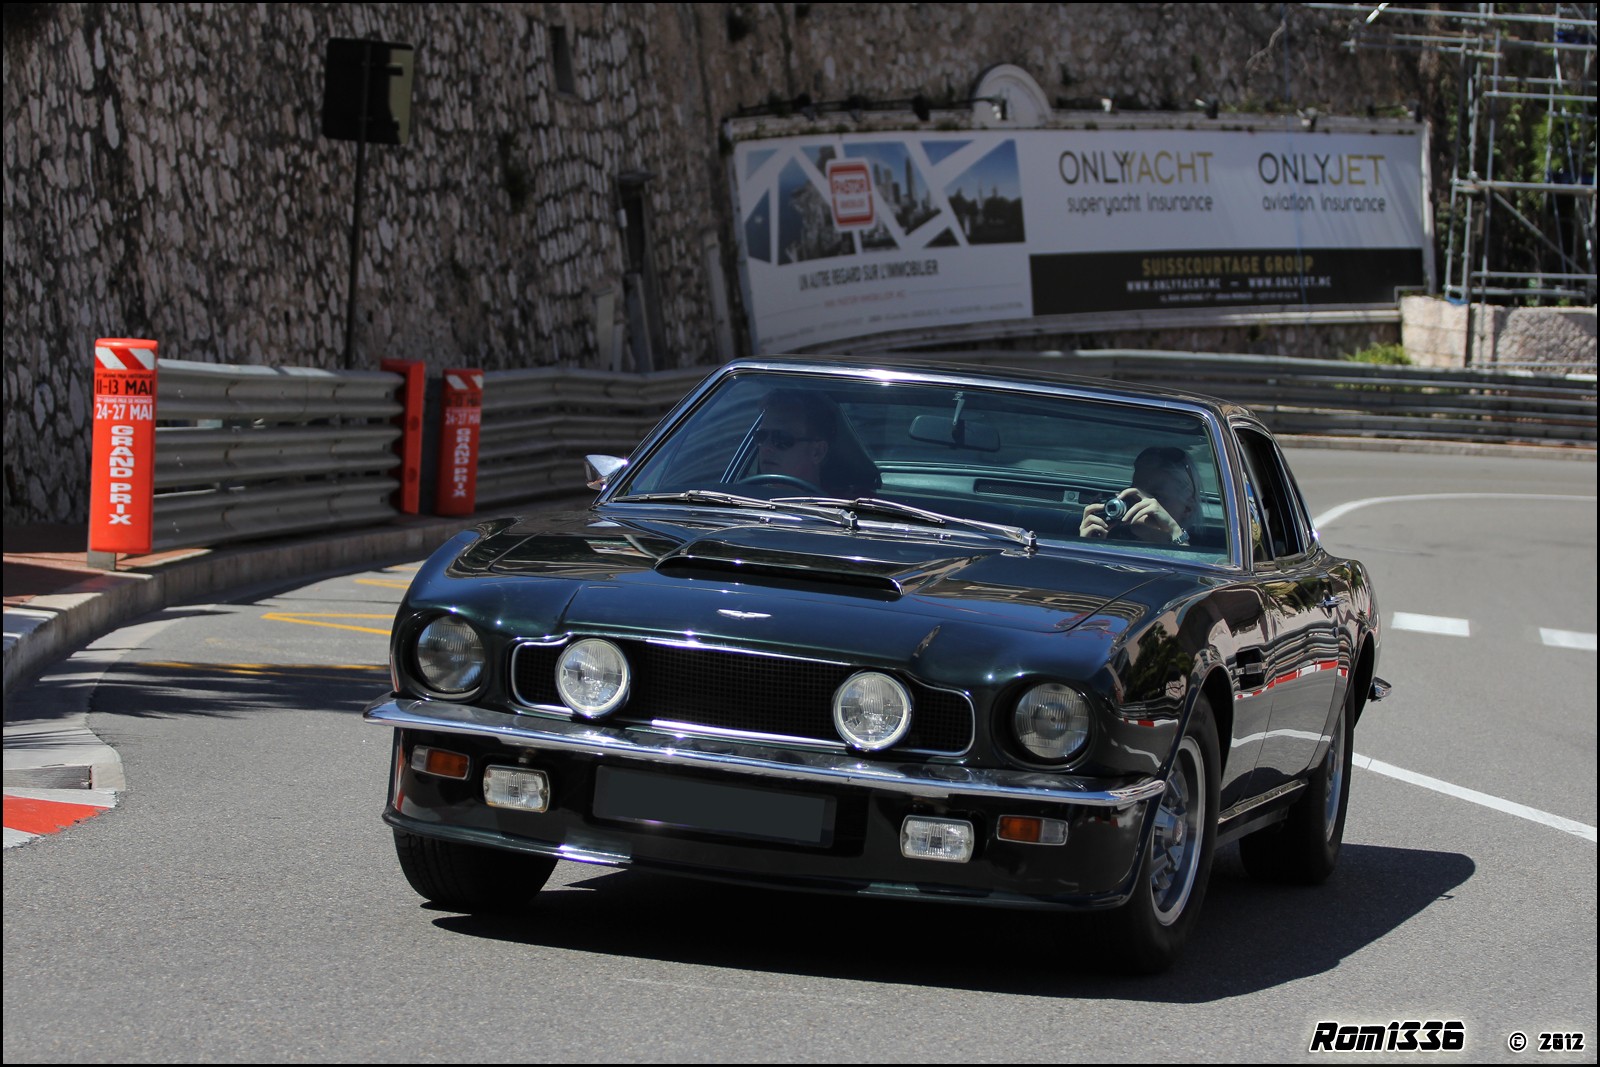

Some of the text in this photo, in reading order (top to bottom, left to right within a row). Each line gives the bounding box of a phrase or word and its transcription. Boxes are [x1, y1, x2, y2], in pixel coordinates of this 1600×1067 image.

[1258, 152, 1385, 185] ONLYJET
[1067, 191, 1213, 217] superyacht insurance
[1262, 192, 1386, 213] aviation insurance
[831, 265, 861, 286] REGARD
[862, 262, 878, 282] SUR
[1142, 255, 1314, 276] SUISSCOURTAGE GROUP
[96, 379, 153, 395] 11-13 MAI
[96, 403, 153, 421] 24-27 MAI
[455, 428, 471, 465] GRAND
[109, 426, 134, 525] GRAND PRIX
[453, 467, 468, 498] PRIX
